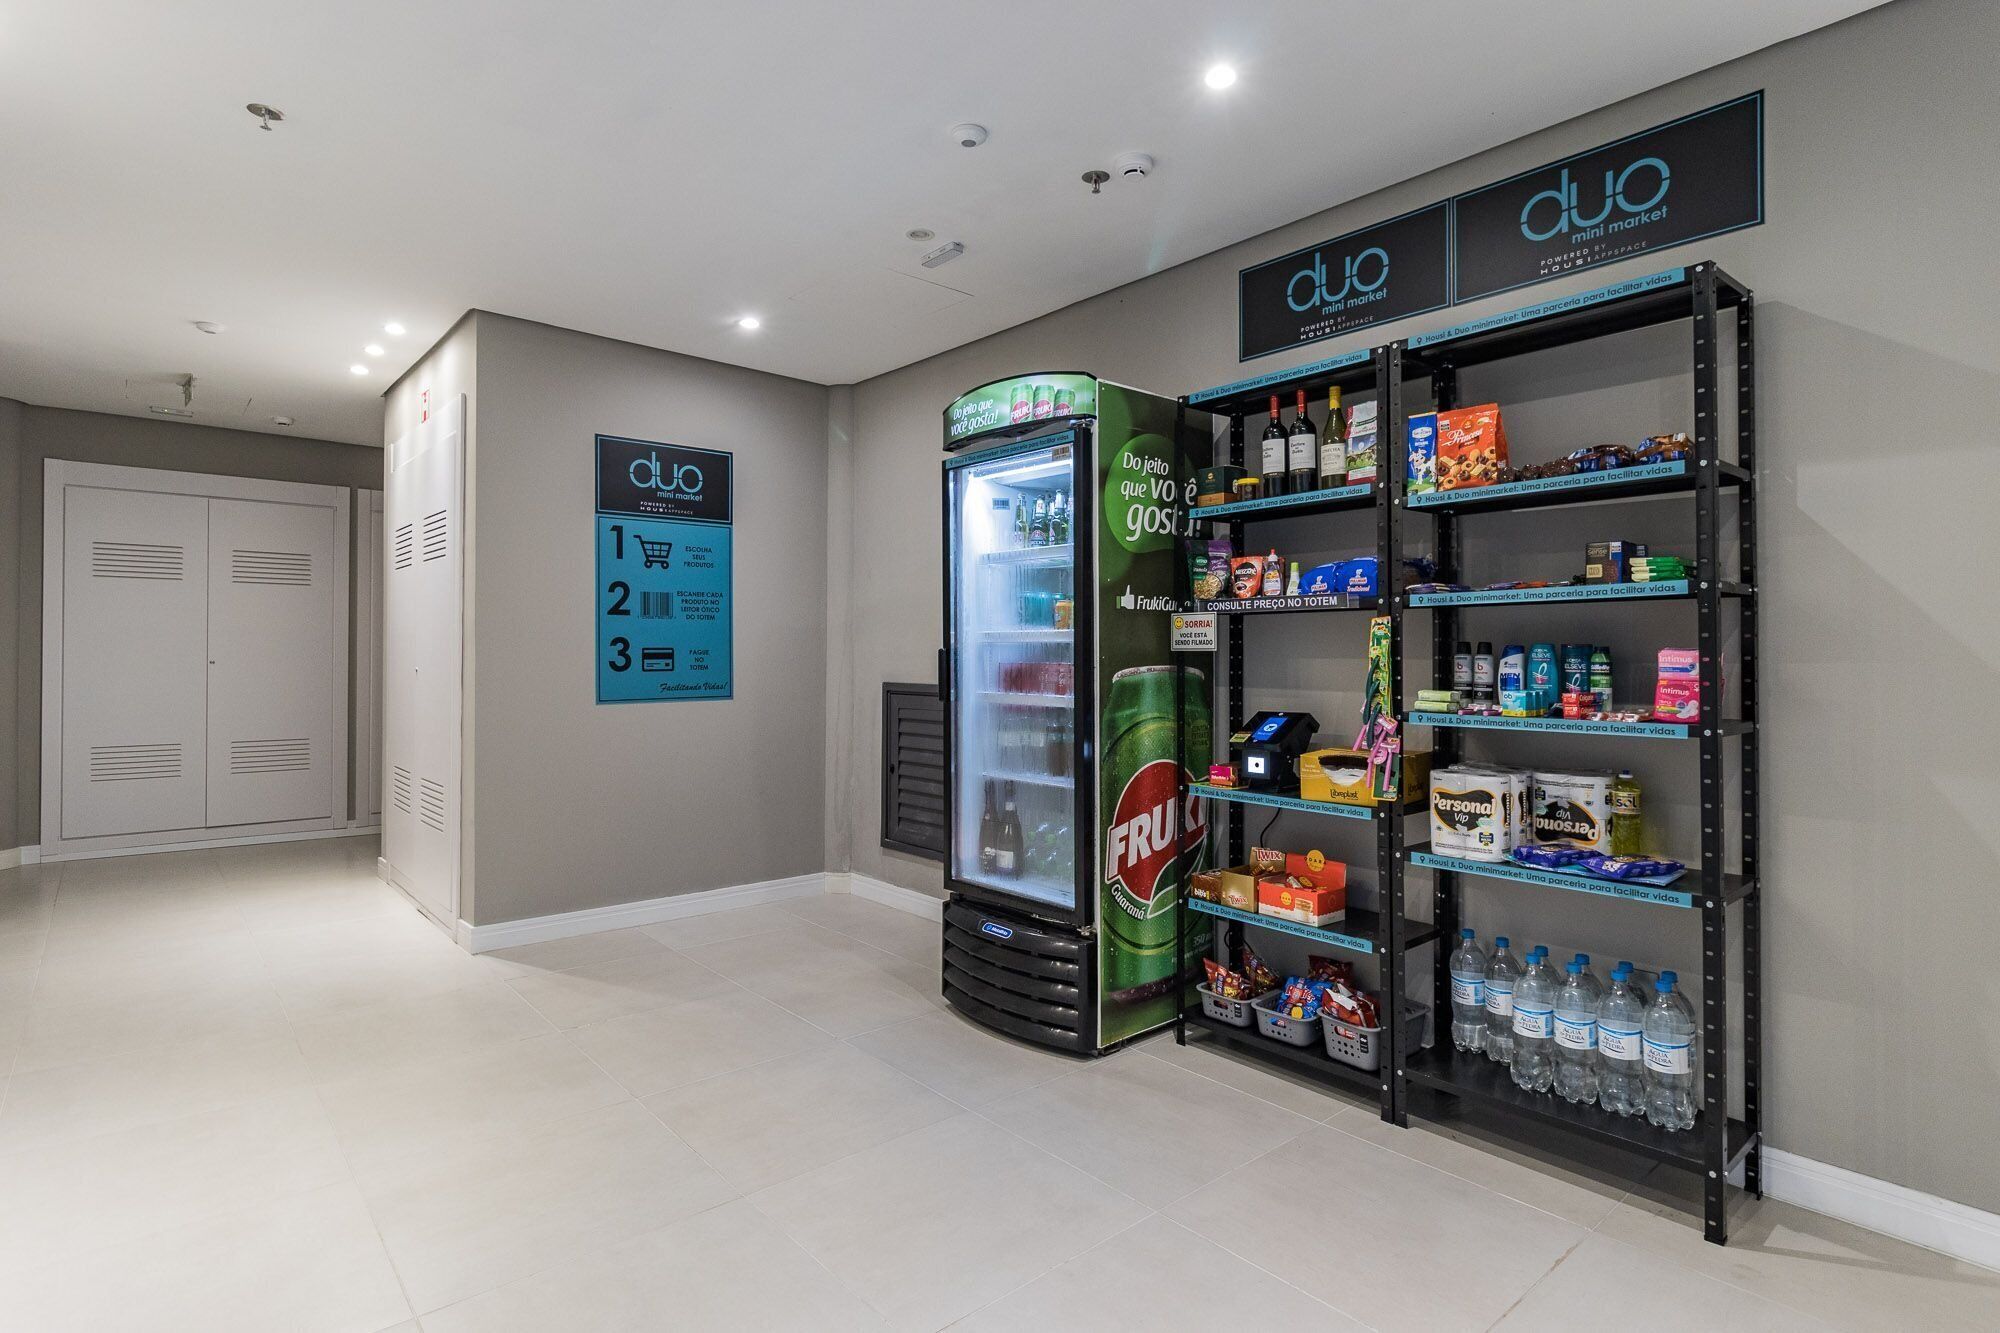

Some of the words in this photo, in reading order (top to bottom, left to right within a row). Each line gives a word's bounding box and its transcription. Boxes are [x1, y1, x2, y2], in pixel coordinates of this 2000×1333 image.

[1521, 158, 1670, 241] duo
[1572, 224, 1603, 244] mini
[1609, 205, 1668, 234] market
[1540, 257, 1590, 275] HOUSI
[1594, 241, 1646, 260] APPSPACE
[1541, 249, 1589, 266] POWERED
[1287, 248, 1389, 311] duo
[1323, 300, 1344, 315] mini
[1348, 288, 1387, 308] market
[1425, 330, 1445, 342] Housi
[1454, 324, 1469, 335] Duo
[1472, 312, 1519, 330] minimarket:
[1521, 307, 1539, 318] Uma
[1543, 297, 1579, 313] parceria
[1583, 292, 1604, 303] para
[1607, 281, 1642, 297] facilitar
[1646, 273, 1672, 287] vidas
[1301, 320, 1334, 332] POWERED
[1338, 316, 1373, 330] APPSPACE
[1265, 374, 1277, 383] Uma
[1280, 367, 1303, 380] parceria
[1305, 365, 1318, 373] para
[1320, 357, 1343, 369] facilitar
[1345, 352, 1362, 362] vidas
[951, 420, 967, 436] você
[968, 409, 998, 434] gosta!
[954, 409, 963, 420] Do
[963, 402, 976, 419] jeito
[978, 399, 993, 413] que
[630, 452, 702, 492] duo
[1123, 452, 1141, 470] Do
[1142, 456, 1168, 476] jeito
[1121, 481, 1146, 500] que
[1151, 478, 1197, 505] voê
[1279, 495, 1303, 504] parceria
[1321, 489, 1343, 498] facilitar
[1345, 487, 1362, 495] vidas
[1425, 494, 1444, 502] Housi
[1454, 491, 1469, 499] Duo
[1472, 484, 1518, 497] minimarket:
[1521, 482, 1540, 491] Uma
[1544, 476, 1580, 489] parceria
[1583, 475, 1604, 484] para
[1608, 468, 1642, 480] facilitar
[1646, 465, 1672, 475] vidas
[610, 525, 623, 559] 1
[607, 581, 630, 615] 2
[1207, 600, 1251, 611] CONSULTE
[1254, 599, 1285, 610] PREÇO
[1288, 598, 1301, 607] NO
[1304, 596, 1337, 606] TOTEM
[1474, 592, 1521, 601] minimarket:
[1546, 589, 1583, 598] parceria
[1611, 585, 1645, 594] facilitar
[1650, 584, 1676, 592] vidas
[609, 637, 631, 672] 3
[1659, 654, 1692, 663] Intimus
[660, 683, 701, 693] Facilitando
[703, 682, 728, 690] Vidas!
[1660, 687, 1689, 695] Intimus
[1474, 718, 1521, 727] minimarket:
[1546, 721, 1582, 731] parceria
[1610, 724, 1646, 733] facilitar
[1650, 726, 1676, 735] vidas
[1233, 793, 1264, 802] minimarket:
[1280, 799, 1304, 808] parceria
[1322, 804, 1344, 813] facilitar
[1346, 807, 1363, 815] vidas
[1433, 792, 1497, 816] Personal
[1556, 809, 1571, 820] Vip
[1454, 813, 1468, 823] Vip
[1428, 858, 1448, 867] Housi
[1458, 862, 1473, 871] Duo
[1476, 865, 1524, 878] minimarket:
[1526, 872, 1545, 882] Uma
[1549, 876, 1585, 889] parceria
[1589, 883, 1610, 893] para
[1614, 885, 1649, 898] facilitar
[1653, 891, 1679, 902] vidas
[1111, 884, 1144, 920] Guaraná
[1232, 910, 1263, 924] minimarket:
[1265, 918, 1278, 927] Uma
[1280, 922, 1304, 934] parceria
[1306, 929, 1320, 938] para
[1347, 937, 1364, 948] vidas
